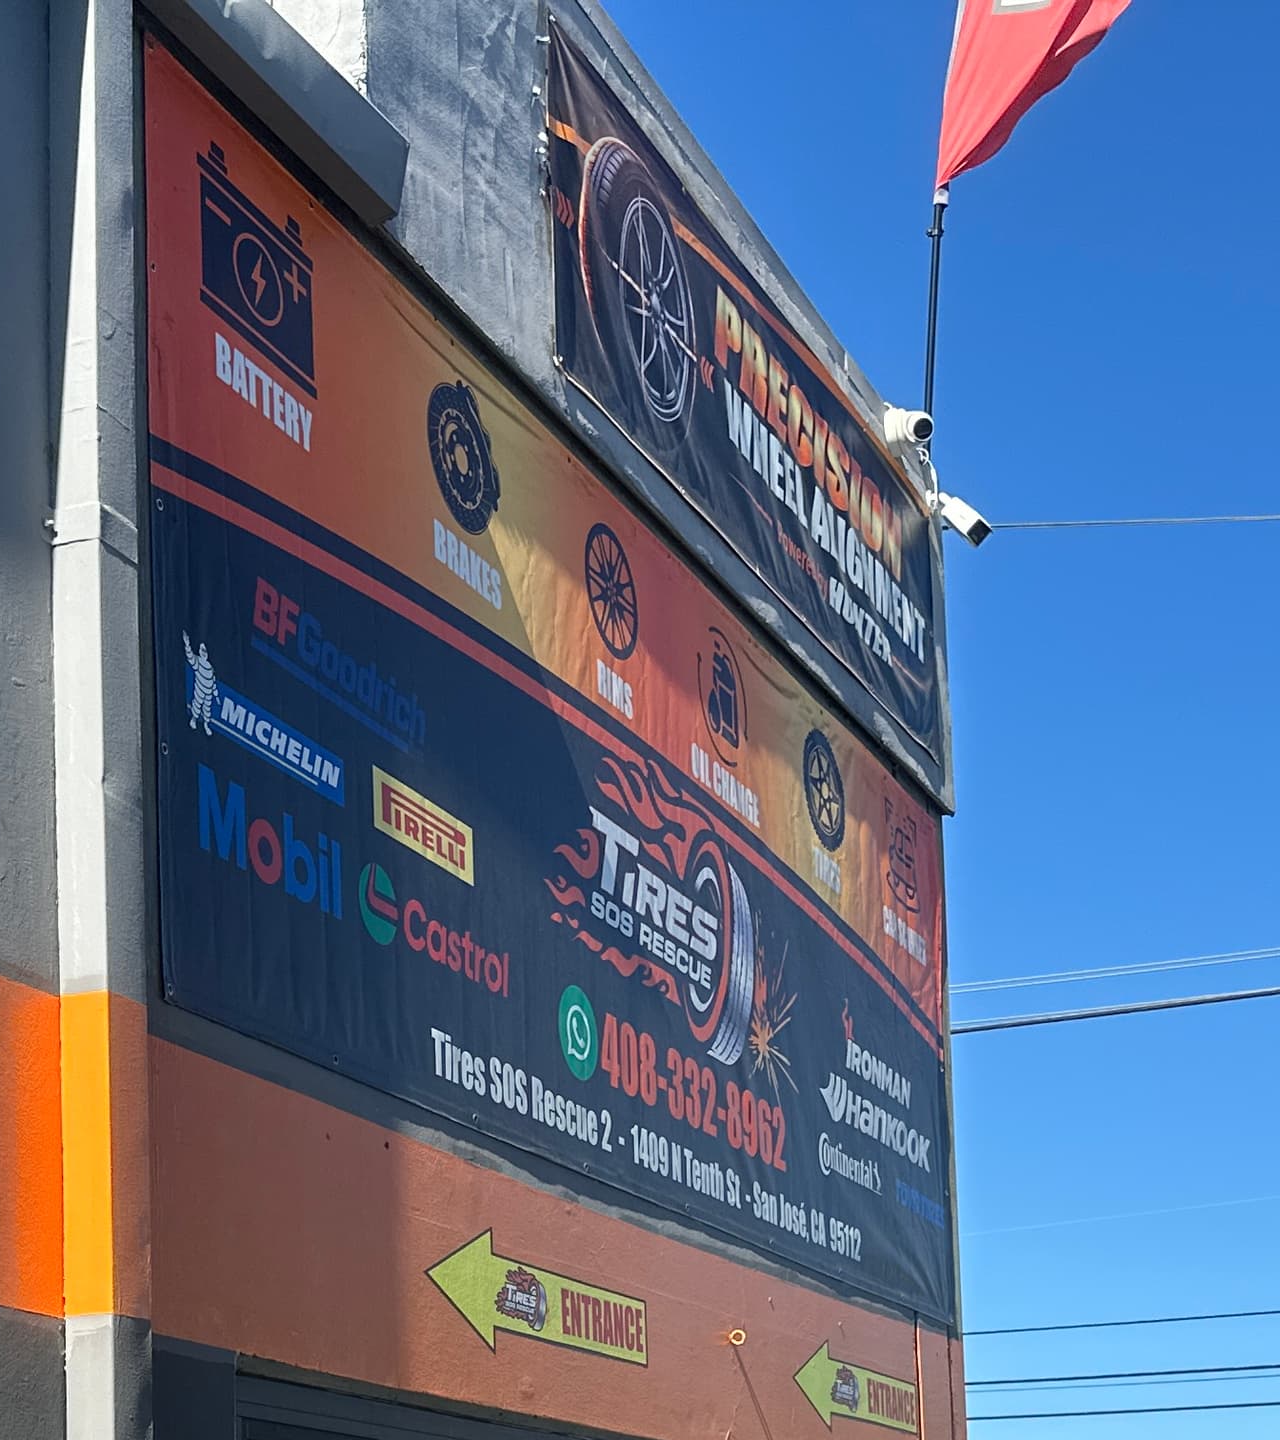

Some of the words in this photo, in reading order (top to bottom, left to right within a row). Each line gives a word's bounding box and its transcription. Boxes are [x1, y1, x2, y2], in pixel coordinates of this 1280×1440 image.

[215, 332, 312, 452] BATTERY
[715, 285, 902, 583] PRECISION
[433, 518, 503, 611] BRAKES
[723, 377, 808, 530] WHEEL
[811, 486, 926, 664] ALIGNMENT
[253, 575, 427, 745] BFGoodrich
[596, 658, 634, 721] RIMS
[221, 696, 341, 789] MICHELIN
[691, 742, 712, 789] OIL
[712, 760, 761, 829] CHANGE
[198, 762, 343, 921] Mobil
[381, 782, 466, 871] PIRELLI
[403, 899, 510, 998] Castrol
[590, 890, 634, 938] SOS
[639, 922, 713, 990] RESCUE
[601, 1012, 788, 1173] 408-332-8962
[846, 1038, 912, 1110] IRONMAN
[430, 1027, 487, 1097] Tires
[489, 1056, 529, 1116] SOS
[531, 1075, 599, 1147] Rescue
[601, 1109, 613, 1153] 2
[631, 1124, 670, 1177] 1409
[671, 1141, 683, 1184] N
[684, 1147, 725, 1202] Tenth
[726, 1167, 742, 1210] St
[753, 1180, 778, 1226] San
[779, 1193, 810, 1244] José,
[810, 1208, 827, 1248] CA
[829, 1217, 862, 1262] 95112
[819, 1132, 874, 1190] Continental
[560, 1287, 644, 1353] ENTRANCE
[866, 1377, 916, 1426] ENTRANCE
